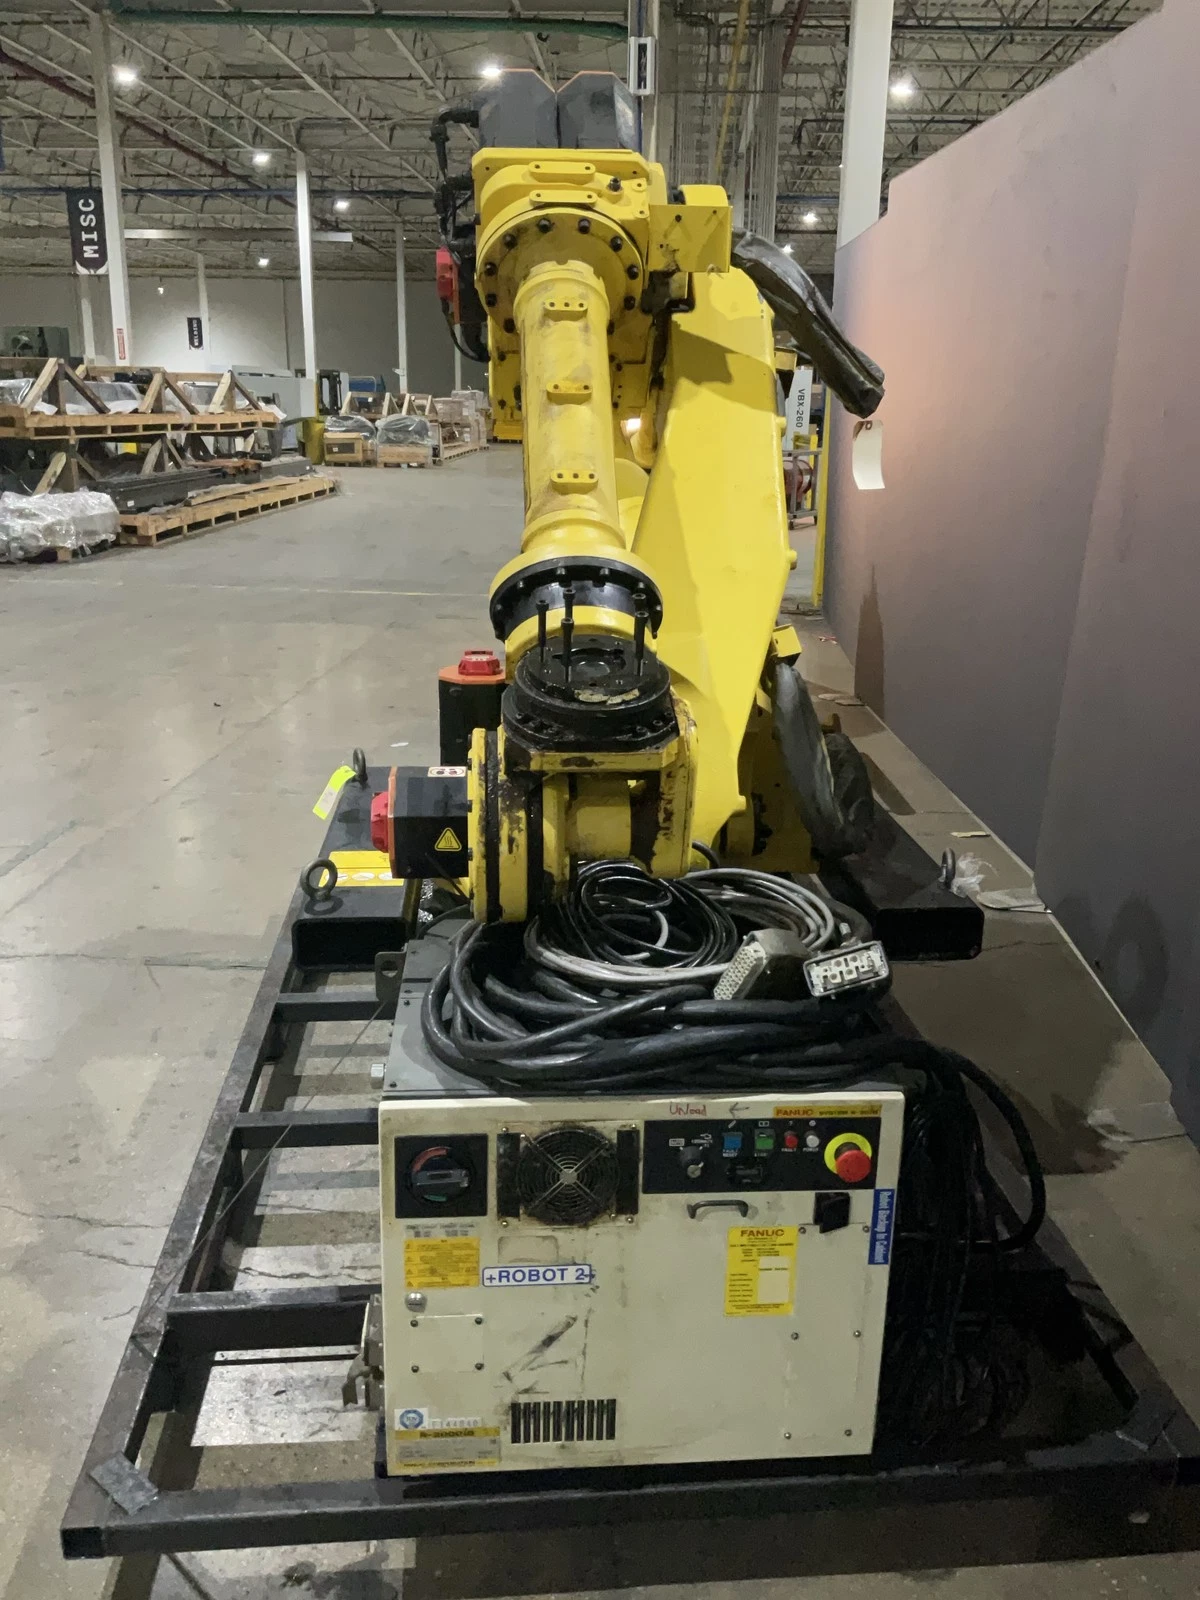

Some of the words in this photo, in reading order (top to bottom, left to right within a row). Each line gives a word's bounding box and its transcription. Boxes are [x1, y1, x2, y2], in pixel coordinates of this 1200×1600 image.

[79, 198, 99, 258] MISC
[796, 388, 806, 428] VBX-260
[776, 1108, 814, 1117] FANUC
[740, 1228, 785, 1237] FANUC
